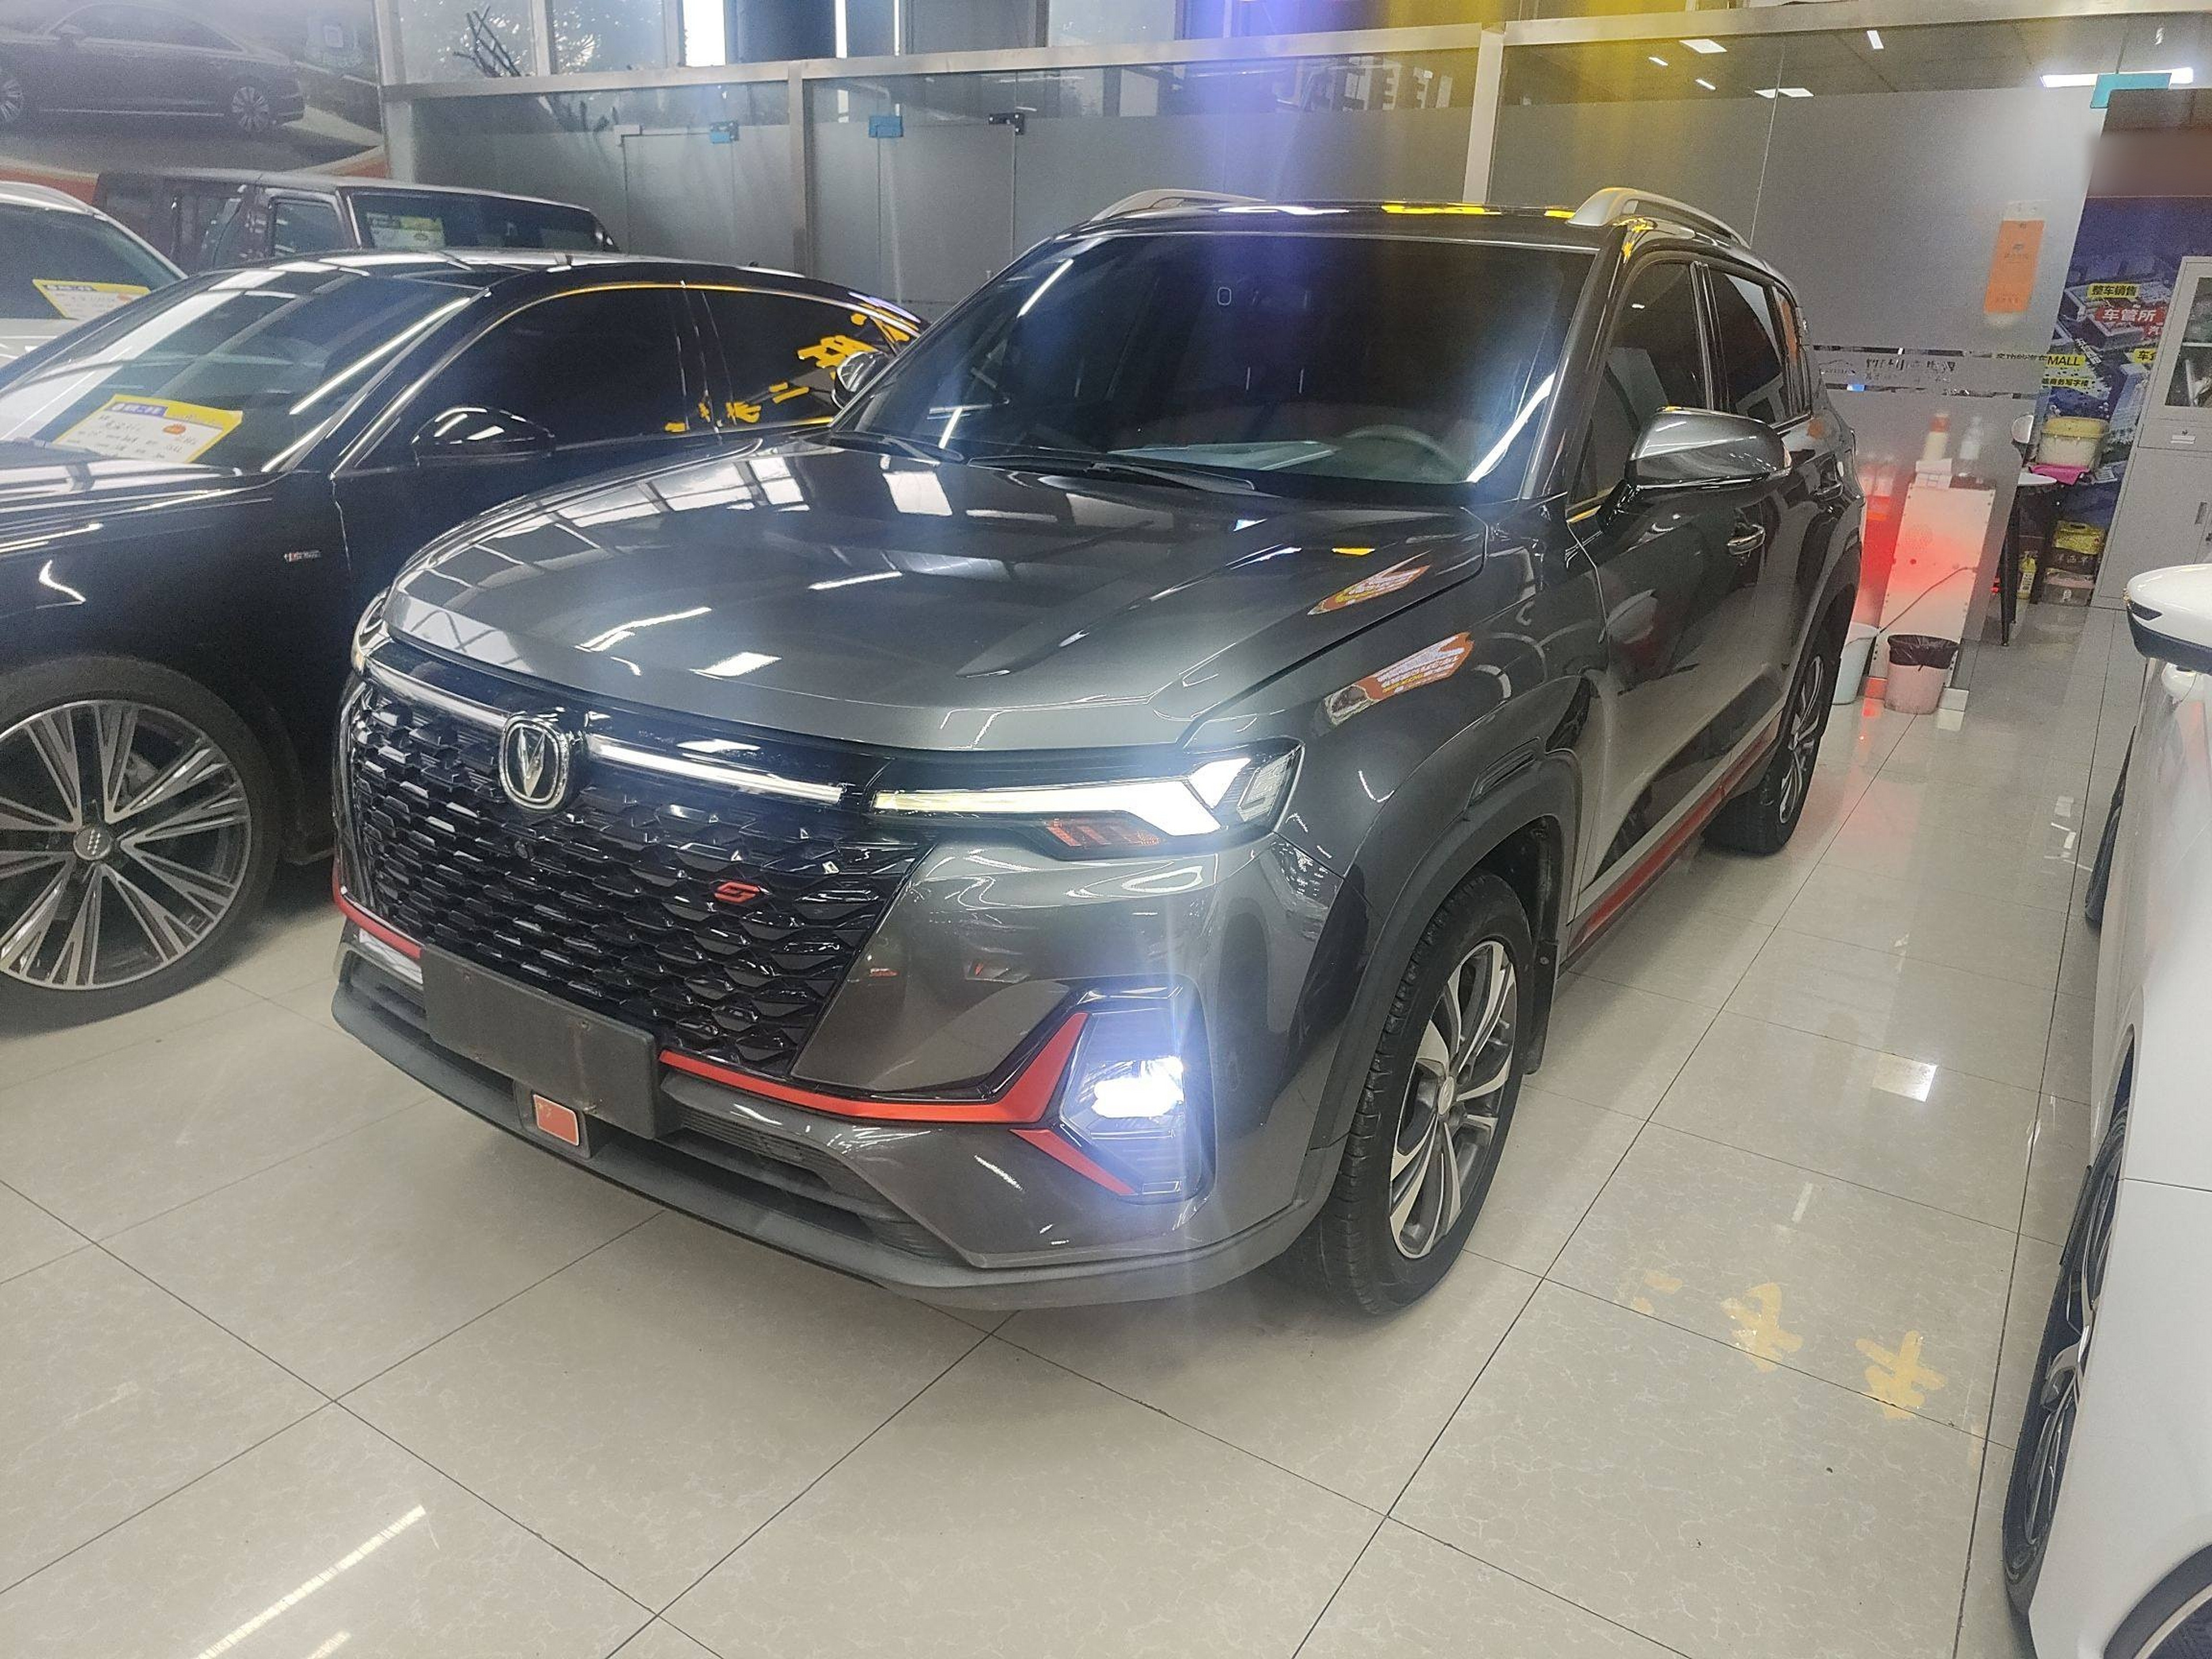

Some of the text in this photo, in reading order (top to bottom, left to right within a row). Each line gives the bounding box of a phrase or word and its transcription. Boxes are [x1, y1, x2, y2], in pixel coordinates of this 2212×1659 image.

[2092, 285, 2138, 296] 整车销售
[2103, 308, 2157, 322] 车管所
[2047, 355, 2081, 366] MALL
